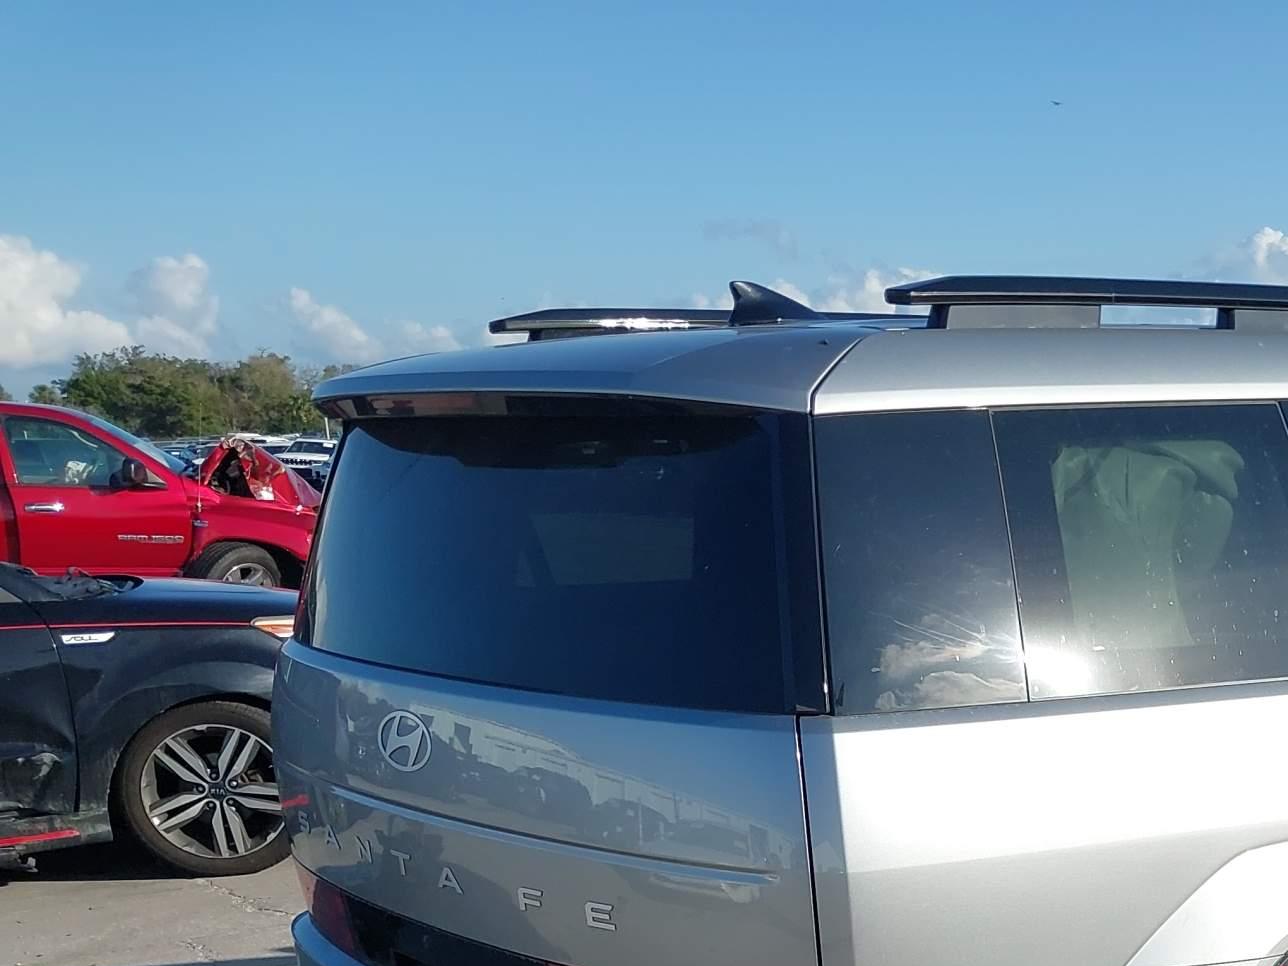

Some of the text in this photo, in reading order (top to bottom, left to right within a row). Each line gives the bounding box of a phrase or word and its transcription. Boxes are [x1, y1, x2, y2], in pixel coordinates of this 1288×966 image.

[210, 788, 225, 796] KIA
[298, 811, 617, 932] SANTA FE
